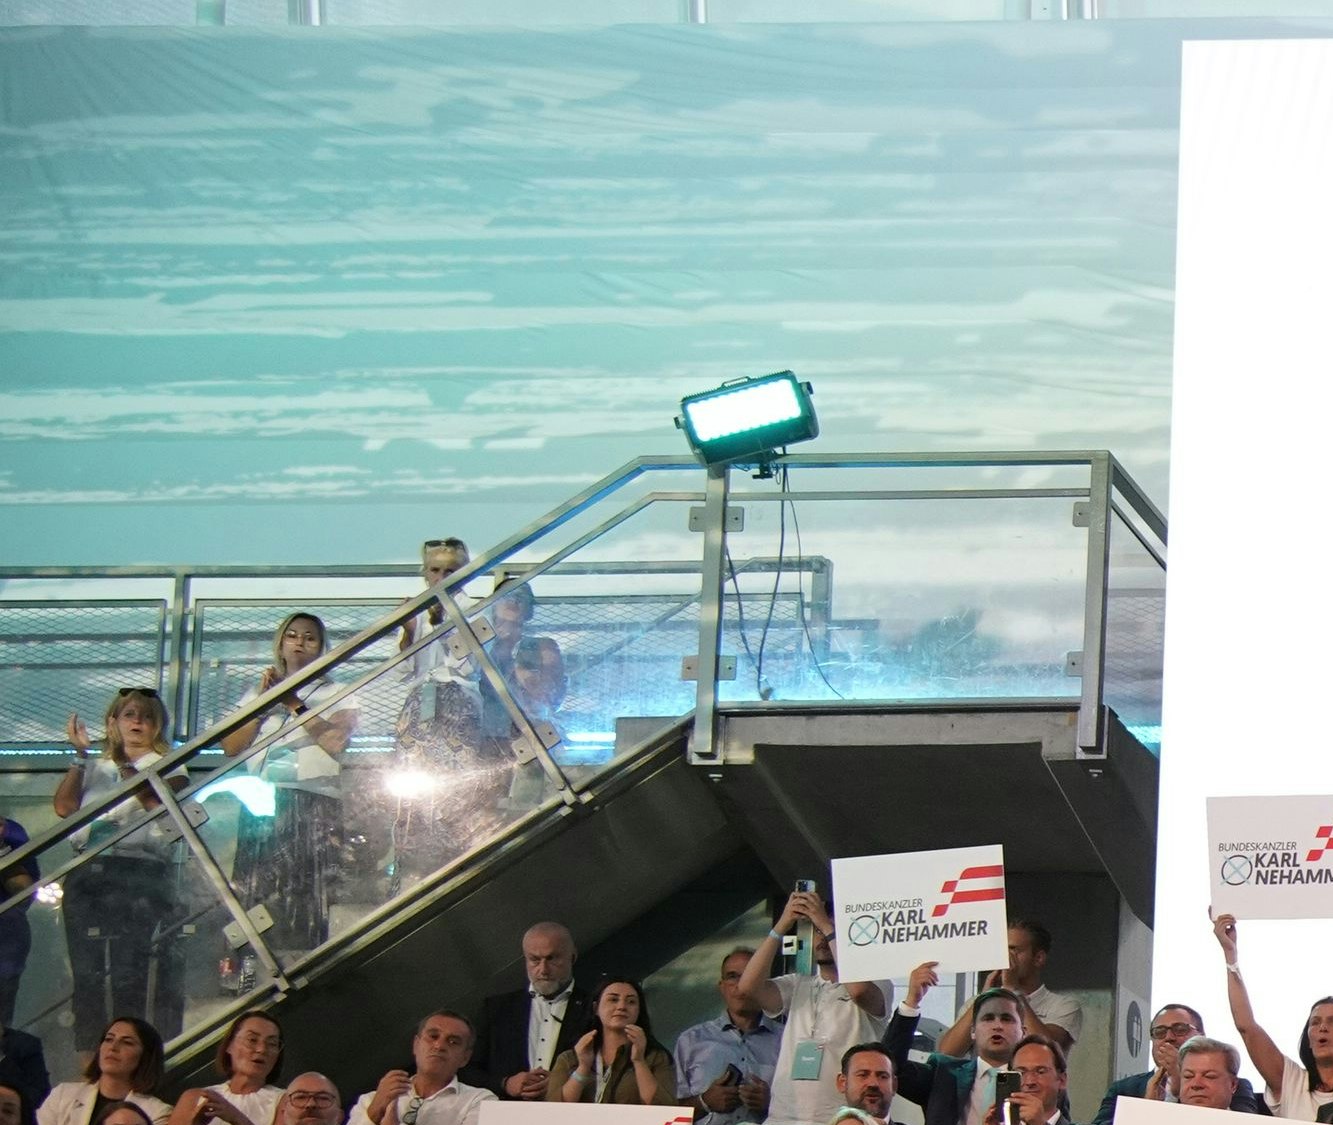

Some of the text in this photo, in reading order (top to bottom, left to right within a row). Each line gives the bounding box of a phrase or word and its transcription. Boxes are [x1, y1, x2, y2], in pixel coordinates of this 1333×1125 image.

[1218, 841, 1297, 853] BUNDESKANZLER
[1254, 852, 1301, 869] KARL
[845, 898, 923, 914] BUNDESKANZLER
[881, 908, 927, 927] KARL
[881, 920, 988, 944] NEHAMMER
